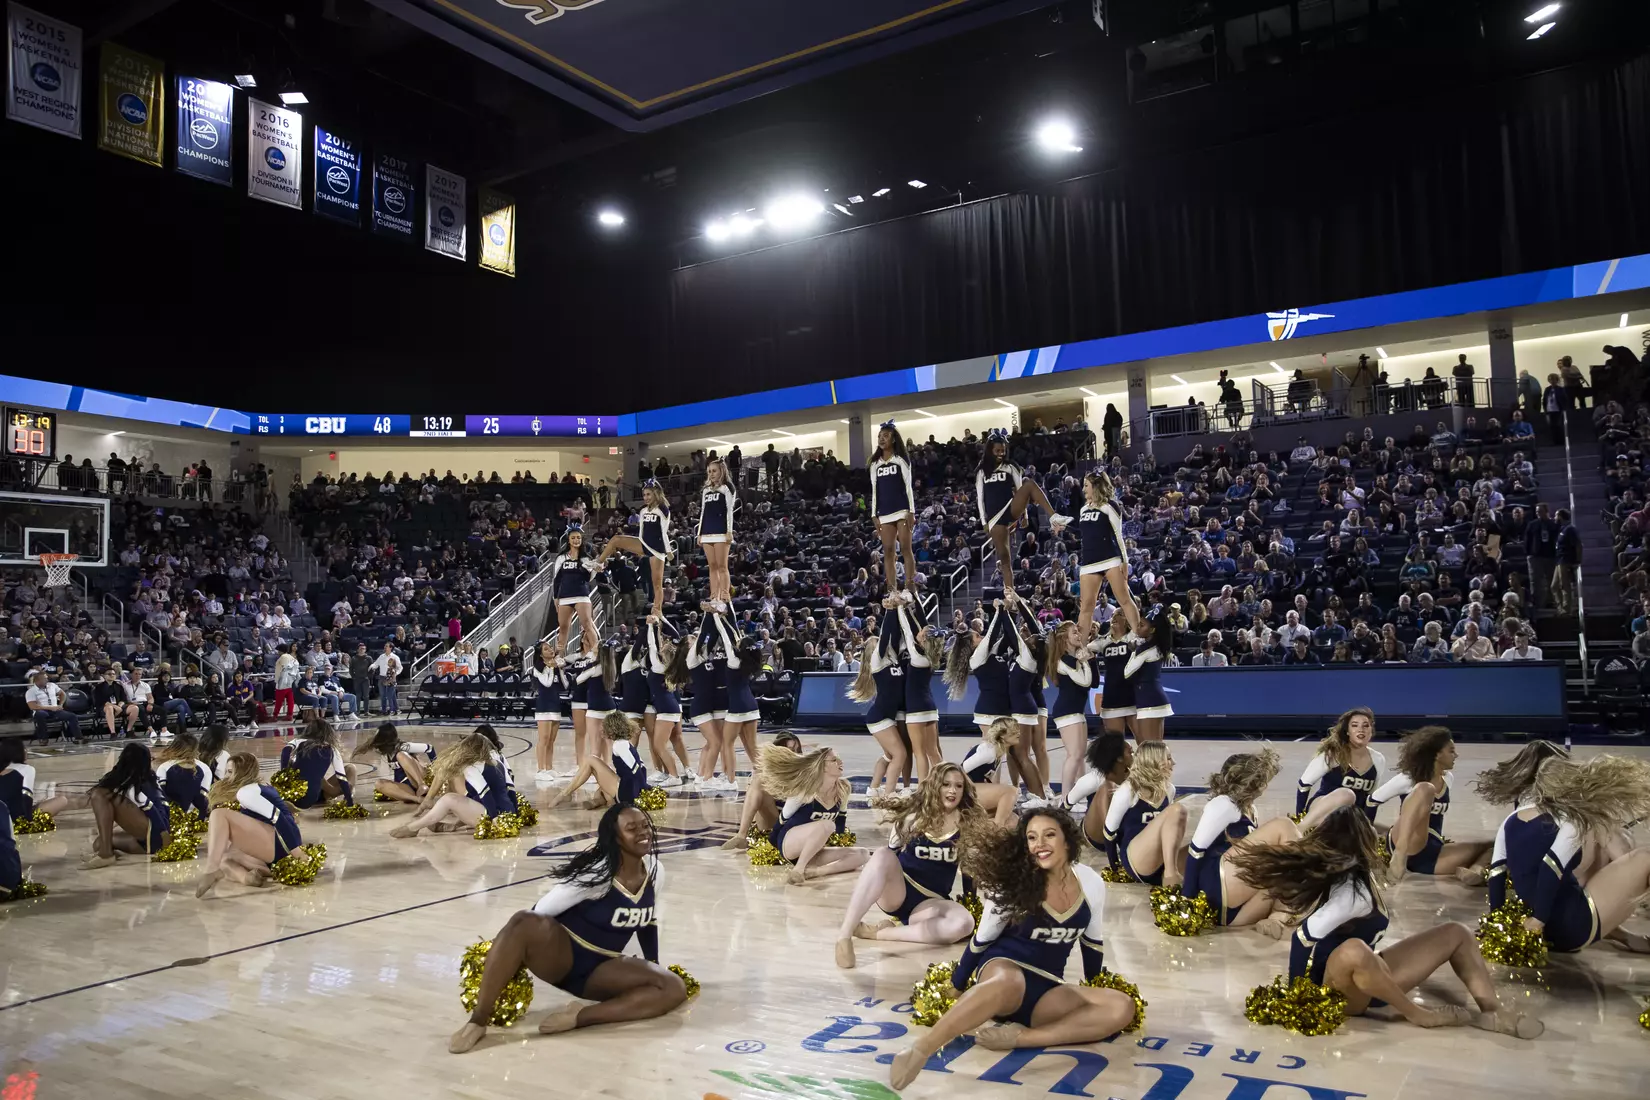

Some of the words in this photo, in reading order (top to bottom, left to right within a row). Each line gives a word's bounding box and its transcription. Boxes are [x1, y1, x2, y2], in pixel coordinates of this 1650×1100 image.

[26, 17, 65, 42] 2015
[12, 40, 79, 69] BASKETBALL
[13, 85, 39, 101] WEST
[41, 95, 78, 113] REGION
[16, 96, 75, 121] CHAMPIONS
[120, 104, 147, 121] NCAA
[178, 100, 230, 125] BASKETBALL
[260, 110, 290, 128] 2016
[107, 120, 149, 139] DIVISION
[256, 121, 293, 140] WOMEN'S
[103, 137, 144, 155] RUNNER
[146, 147, 160, 159] UP
[108, 129, 156, 150] NATIONAL
[252, 129, 299, 151] BASKETBALL
[325, 132, 352, 150] 2017
[178, 146, 230, 168] CHAMPIONS
[320, 142, 355, 161] WOMEN'S
[267, 157, 285, 168] NCAA
[317, 150, 360, 172] BASKETBALL
[382, 154, 408, 172] 2017
[251, 175, 300, 195] TOURNAMENT
[257, 169, 288, 185] DIVISION
[435, 174, 458, 190] 2017
[317, 191, 360, 210] CHAMPIONS
[375, 210, 414, 229] TOURNAMENT
[377, 218, 412, 235] CHAMPIONS
[258, 415, 269, 424] TOL
[280, 415, 284, 424] 3
[305, 416, 347, 434] CBU
[373, 416, 391, 434] 48
[423, 416, 453, 430] 13:19
[483, 417, 500, 434] 25
[577, 417, 588, 425] TOL
[258, 425, 269, 433] FLS
[577, 427, 587, 435] FLS
[15, 428, 45, 454] 30
[876, 465, 897, 477] CBU
[983, 472, 1007, 483] CBU
[704, 492, 720, 502] CBU
[1080, 512, 1100, 522] CBU
[1105, 645, 1127, 657] CBU
[1341, 776, 1375, 790] CBU
[810, 811, 839, 822] CBU
[915, 845, 957, 862] CBU
[611, 907, 653, 928] CBU
[1030, 927, 1086, 944] CBU
